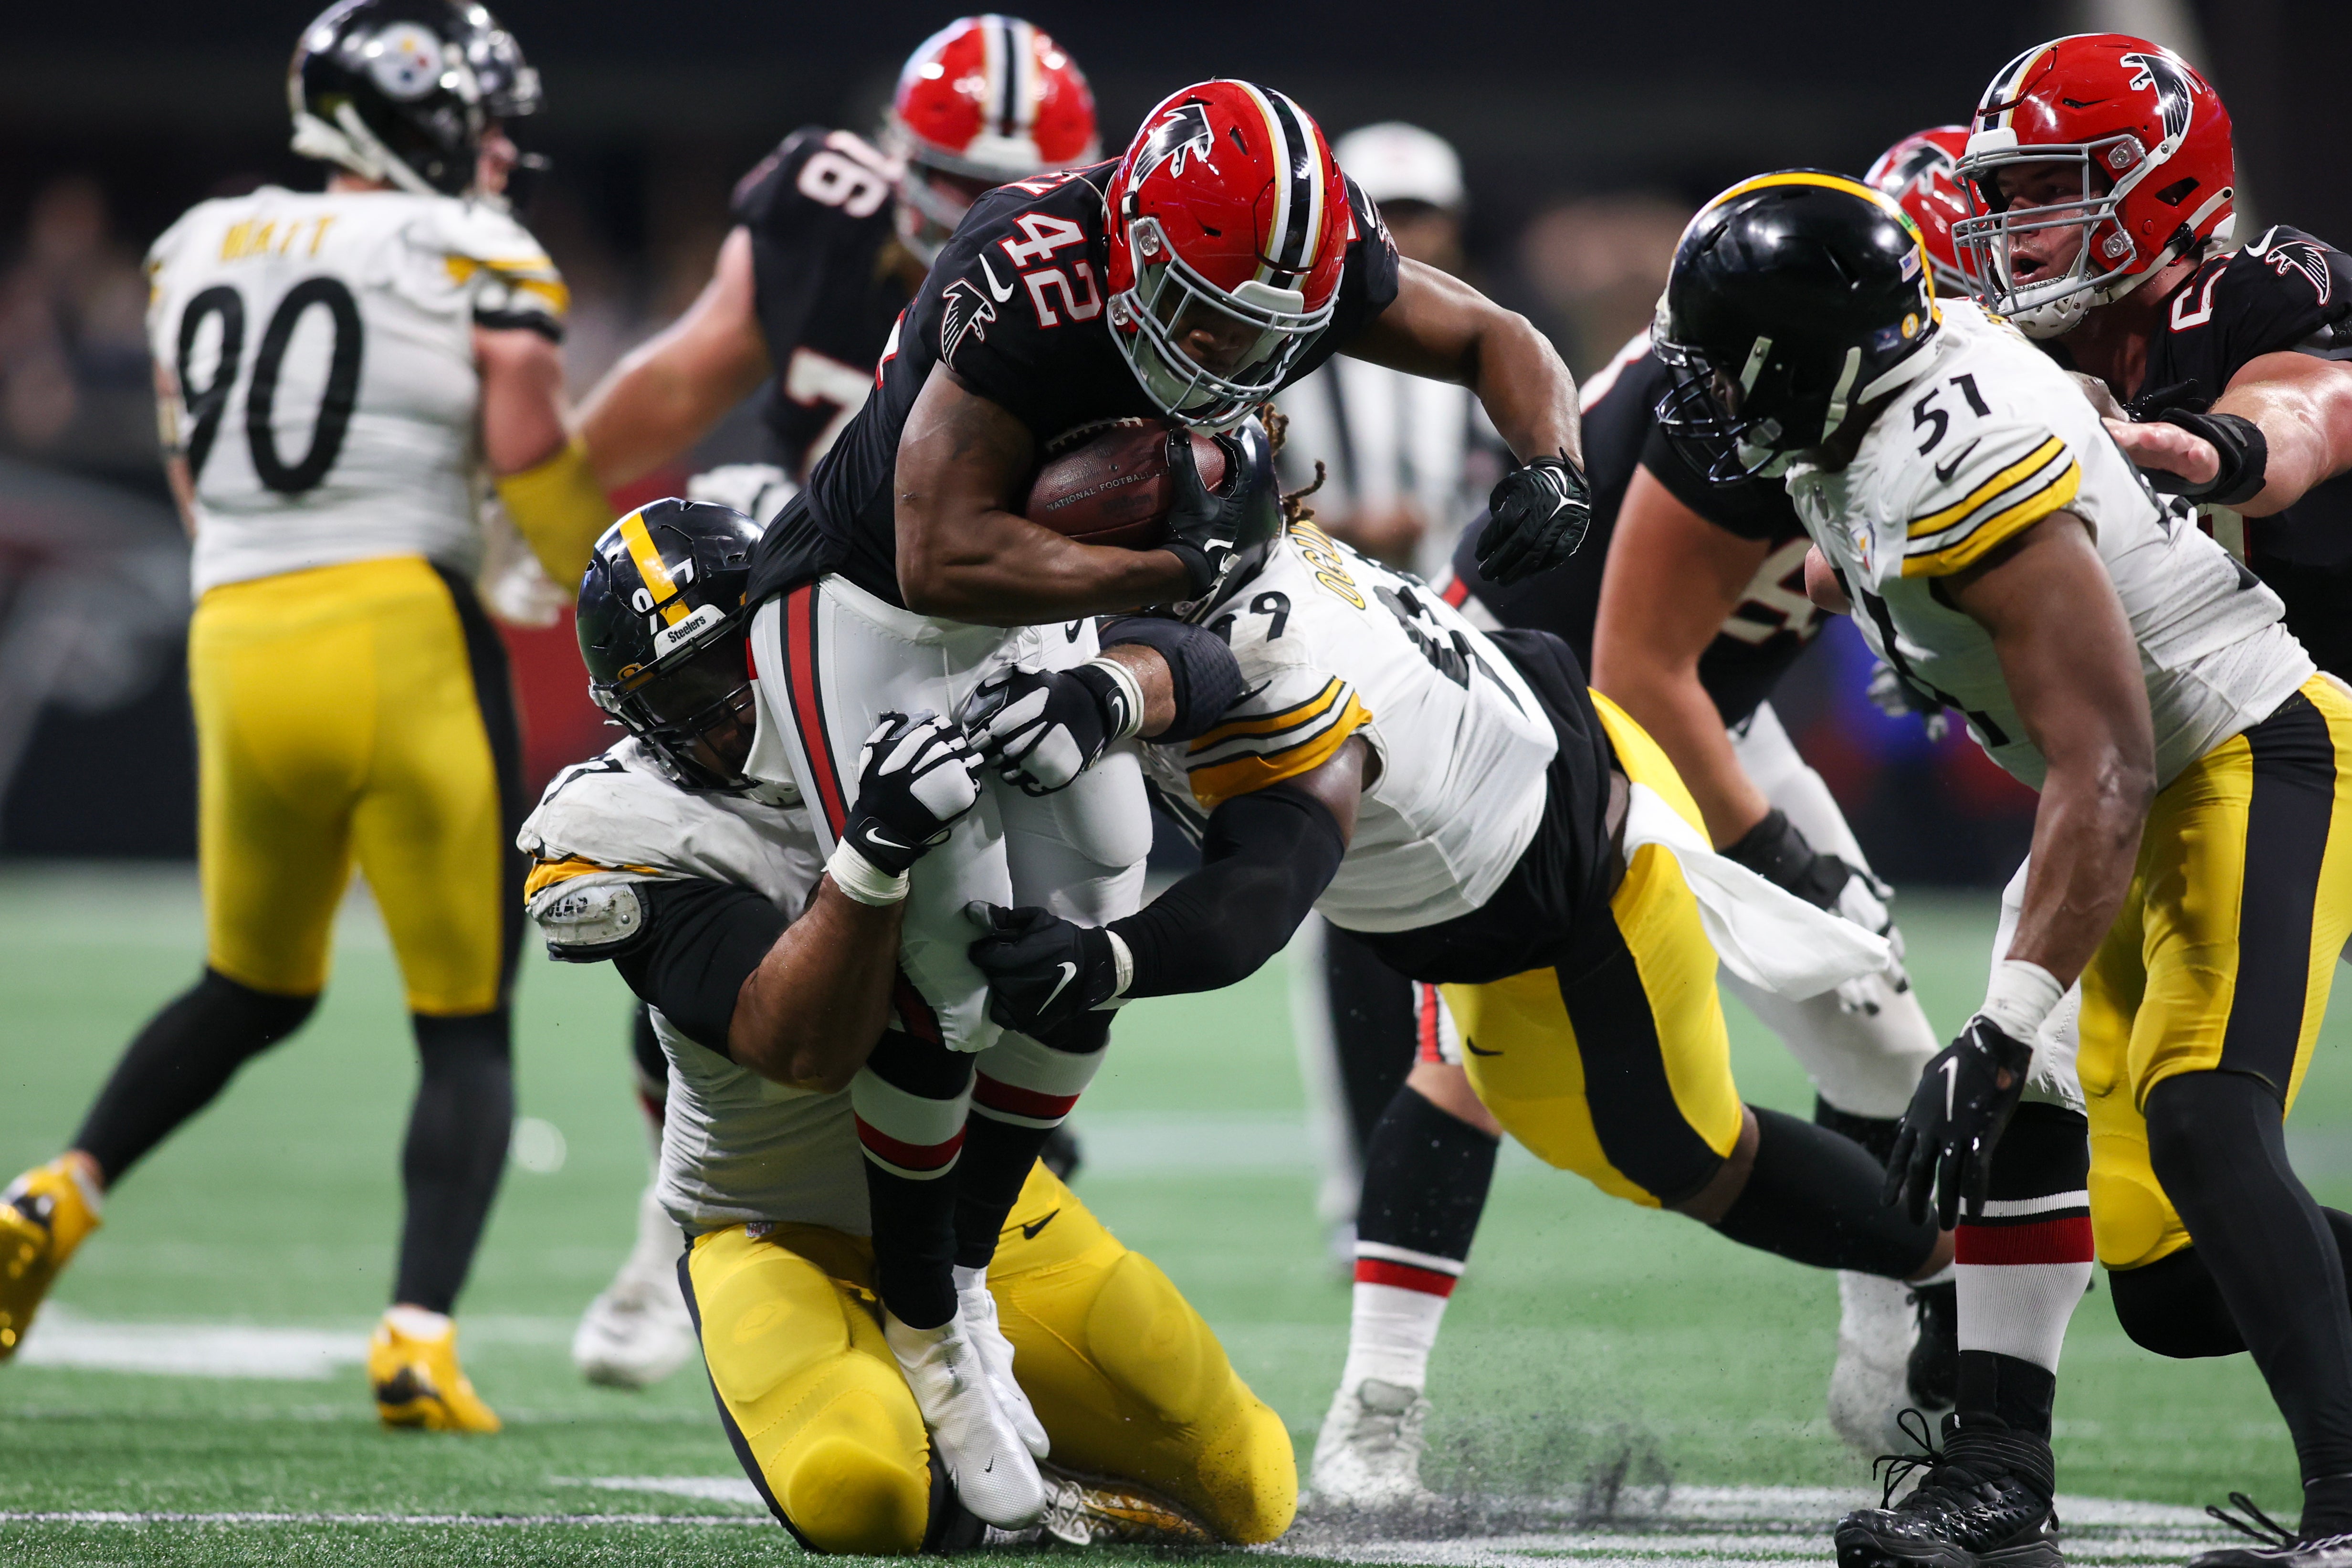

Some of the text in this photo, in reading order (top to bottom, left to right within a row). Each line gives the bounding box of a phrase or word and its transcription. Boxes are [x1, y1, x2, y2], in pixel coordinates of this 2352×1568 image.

[998, 211, 1102, 330] 42
[178, 276, 362, 494] 90
[1912, 373, 1991, 457] 51
[1046, 487, 1096, 512] NATIONAL
[1099, 471, 1151, 492] FOOTBALL
[667, 615, 707, 643] Steelers
